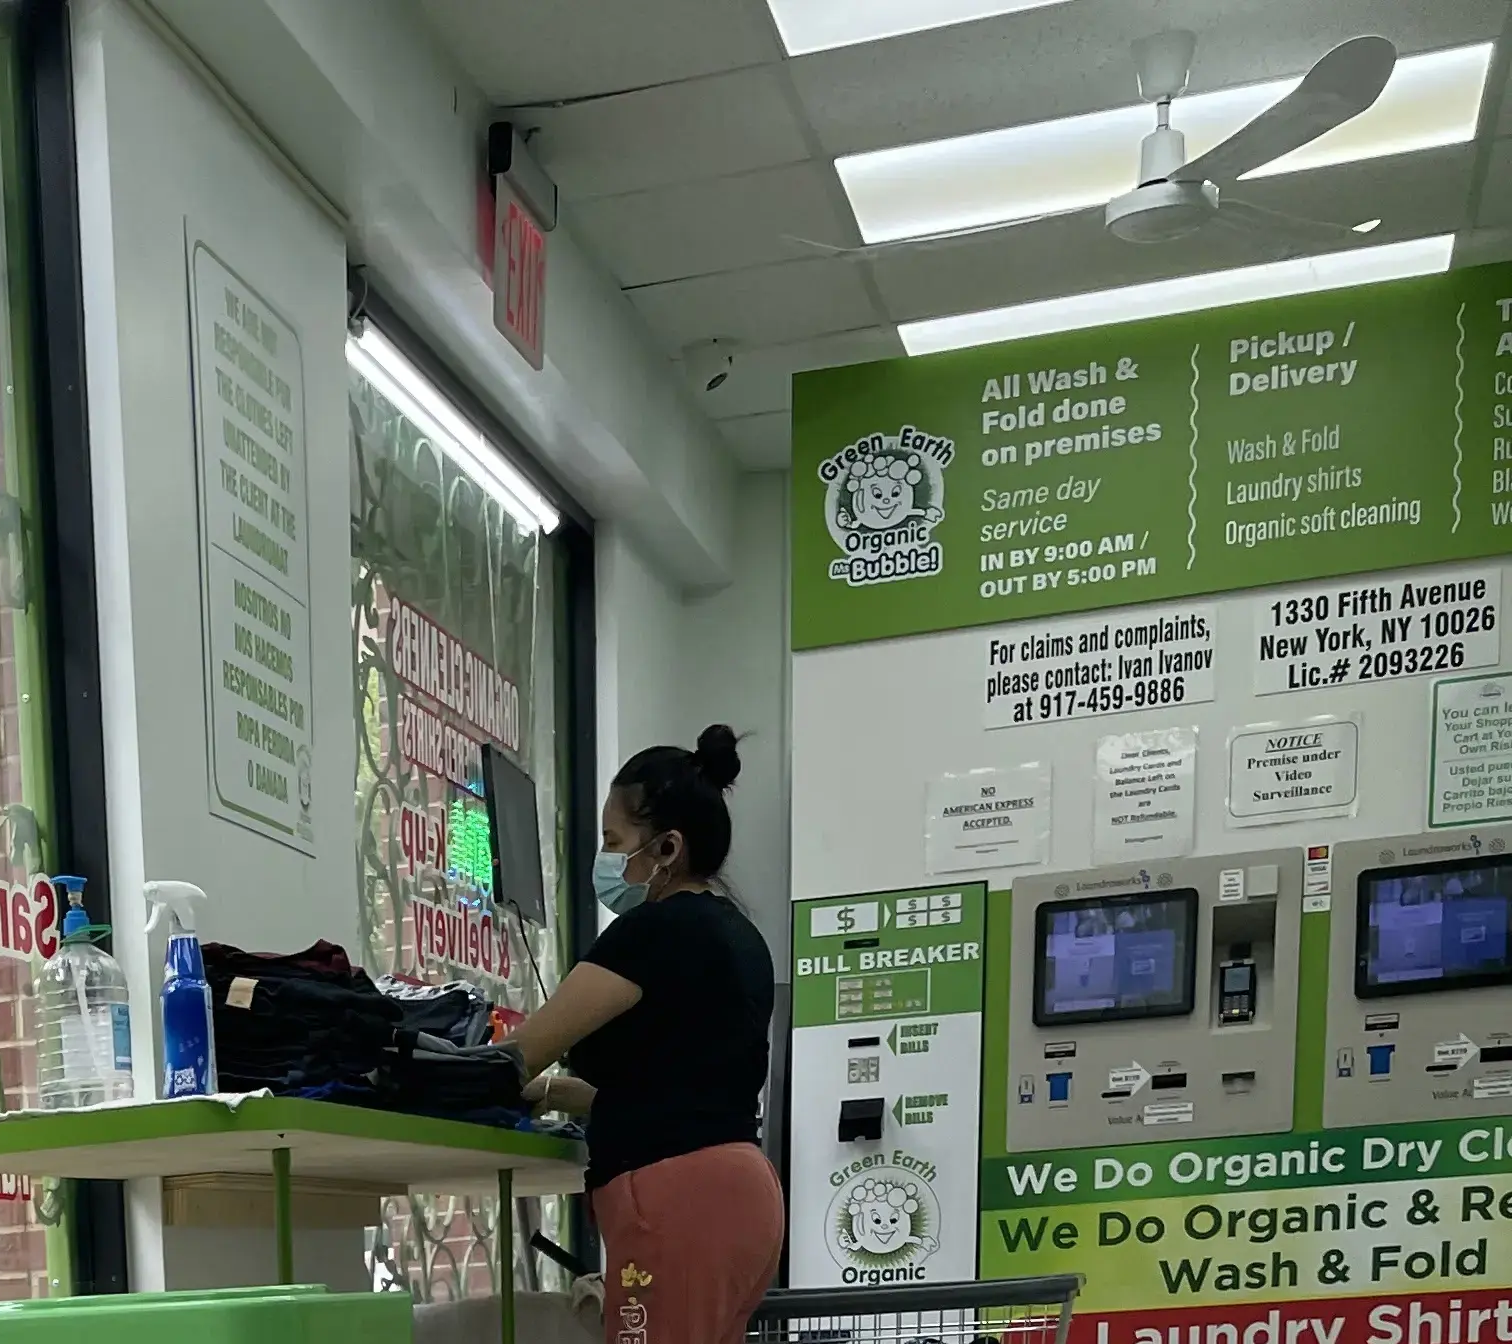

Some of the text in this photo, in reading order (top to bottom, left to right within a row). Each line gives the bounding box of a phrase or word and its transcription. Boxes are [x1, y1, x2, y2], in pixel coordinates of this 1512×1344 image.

[1229, 329, 1335, 363] Pickup
[981, 357, 1139, 402] All Wash &
[1229, 359, 1357, 396] Delivery
[982, 396, 1127, 434] Fold done
[821, 428, 953, 481] Green Earth
[981, 423, 1162, 467] on premises
[1227, 424, 1340, 465] Wash & Fold
[981, 475, 1101, 512] Same day
[1226, 465, 1362, 506] Laundry shirts
[846, 523, 927, 553] Organic
[980, 511, 1068, 542] service
[1225, 497, 1421, 548] Organic soft cleaning
[849, 547, 938, 582] Bubble!
[980, 555, 1004, 572] IN
[1010, 548, 1039, 568] BY
[1044, 540, 1092, 561] 9:00
[1098, 533, 1134, 555] AM
[980, 557, 1157, 598] OUT BY 5:00 PM
[1271, 577, 1487, 627] 1330 Fifth Avenue
[990, 612, 1211, 667] For claims and complaints,
[1260, 604, 1496, 661] New York, NY 10026
[987, 646, 1214, 703] please contact: Ivan Ivanov
[1289, 642, 1465, 690] Lic.# 2093226
[1013, 676, 1186, 723] at 917-459-9886
[1442, 708, 1469, 720] You
[1473, 704, 1500, 717] can
[1265, 733, 1324, 752] NOTICE
[1445, 718, 1512, 732] Your Shopp
[1247, 749, 1341, 770] Premise under
[1491, 741, 1512, 751] Ris
[981, 787, 996, 798] NO
[1253, 783, 1333, 803] Surveillance
[1275, 769, 1313, 782] Video
[995, 797, 1034, 811] EXPRESS
[797, 942, 980, 976] BILL BREAKER
[900, 1040, 930, 1055] BILLS
[829, 1150, 937, 1187] Green Earth
[1007, 1163, 1078, 1196] We
[1094, 1156, 1153, 1190] Do
[1168, 1141, 1346, 1186] Organic
[1363, 1137, 1443, 1173] Dry
[998, 1216, 1079, 1253] We
[1097, 1211, 1165, 1247] Do
[1184, 1193, 1388, 1243] Organic
[1406, 1188, 1440, 1225] &
[842, 1262, 926, 1286] Organic
[1158, 1238, 1487, 1294] Wash & Fold
